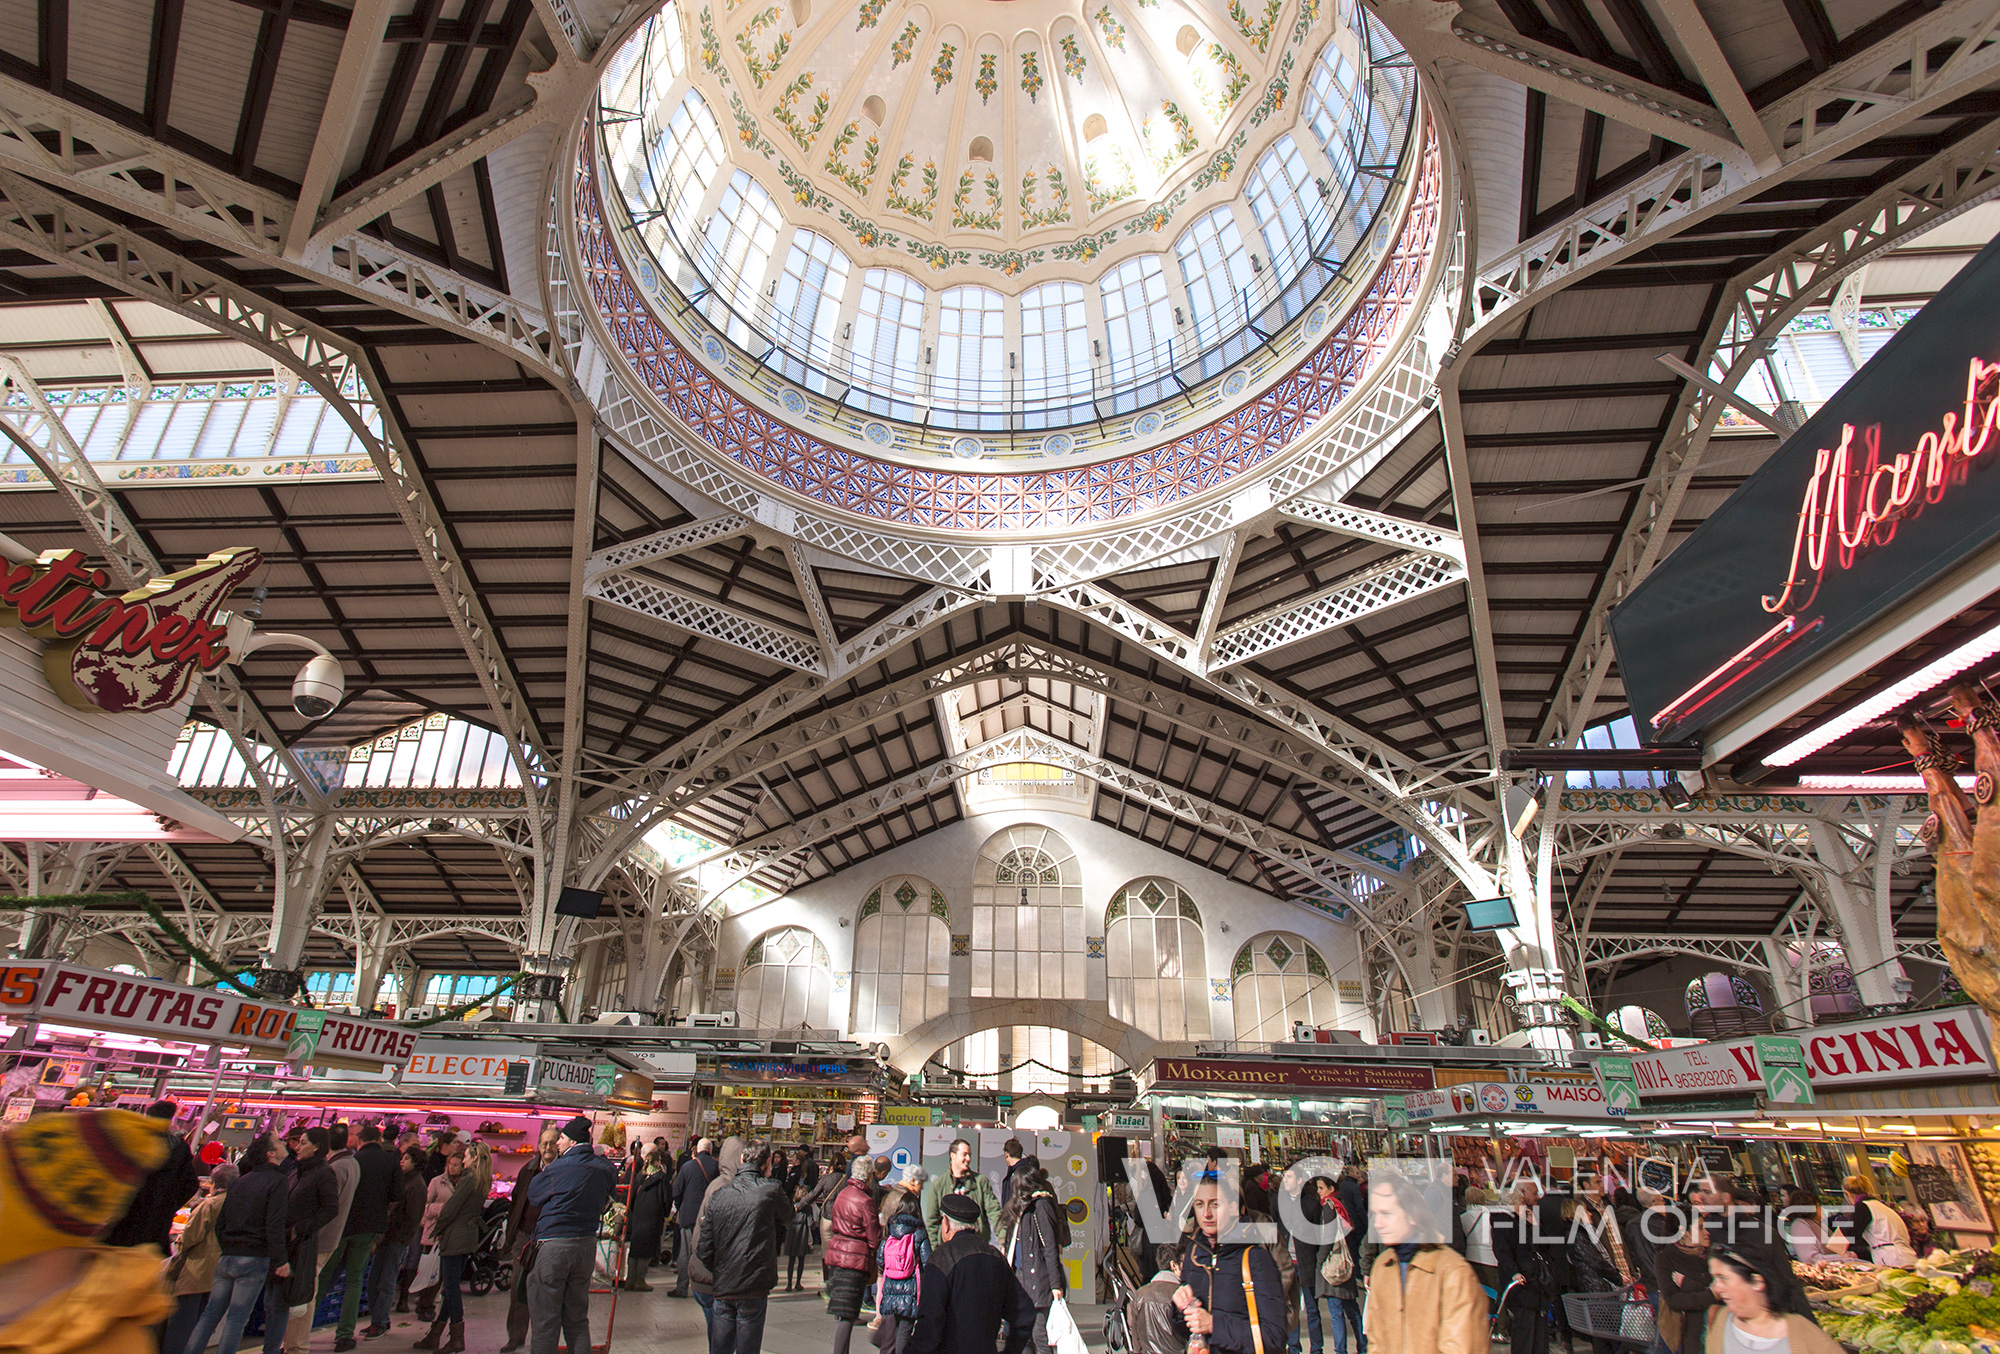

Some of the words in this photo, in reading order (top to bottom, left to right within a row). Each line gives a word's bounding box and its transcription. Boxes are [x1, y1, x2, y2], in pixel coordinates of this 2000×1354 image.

[1761, 356, 2000, 614] Mart
[0, 967, 45, 1005] S
[44, 970, 224, 1030] FRUTAS
[318, 1019, 416, 1059] FRUTAS
[1728, 1018, 1986, 1083] VGINIA
[1761, 1042, 1789, 1053] Servei
[1789, 1046, 1797, 1054] a
[390, 1055, 529, 1077] ELECTA
[1603, 1061, 1624, 1070] Servei
[1683, 1051, 1710, 1067] TEL:
[1764, 1052, 1799, 1063] domicili
[542, 1061, 596, 1085] PUCHADE
[1166, 1062, 1289, 1084] Moixamer
[1344, 1068, 1360, 1077] de
[1364, 1068, 1425, 1078] Saladura
[1310, 1074, 1352, 1083] Olives
[1364, 1076, 1413, 1085] Fumats
[1674, 1068, 1738, 1089] 963829206
[1416, 1093, 1427, 1107] DEL
[1427, 1091, 1445, 1105] QUESO
[1546, 1086, 1605, 1103] MAISO
[888, 1113, 926, 1122] natura
[1115, 1115, 1145, 1126] Rafael
